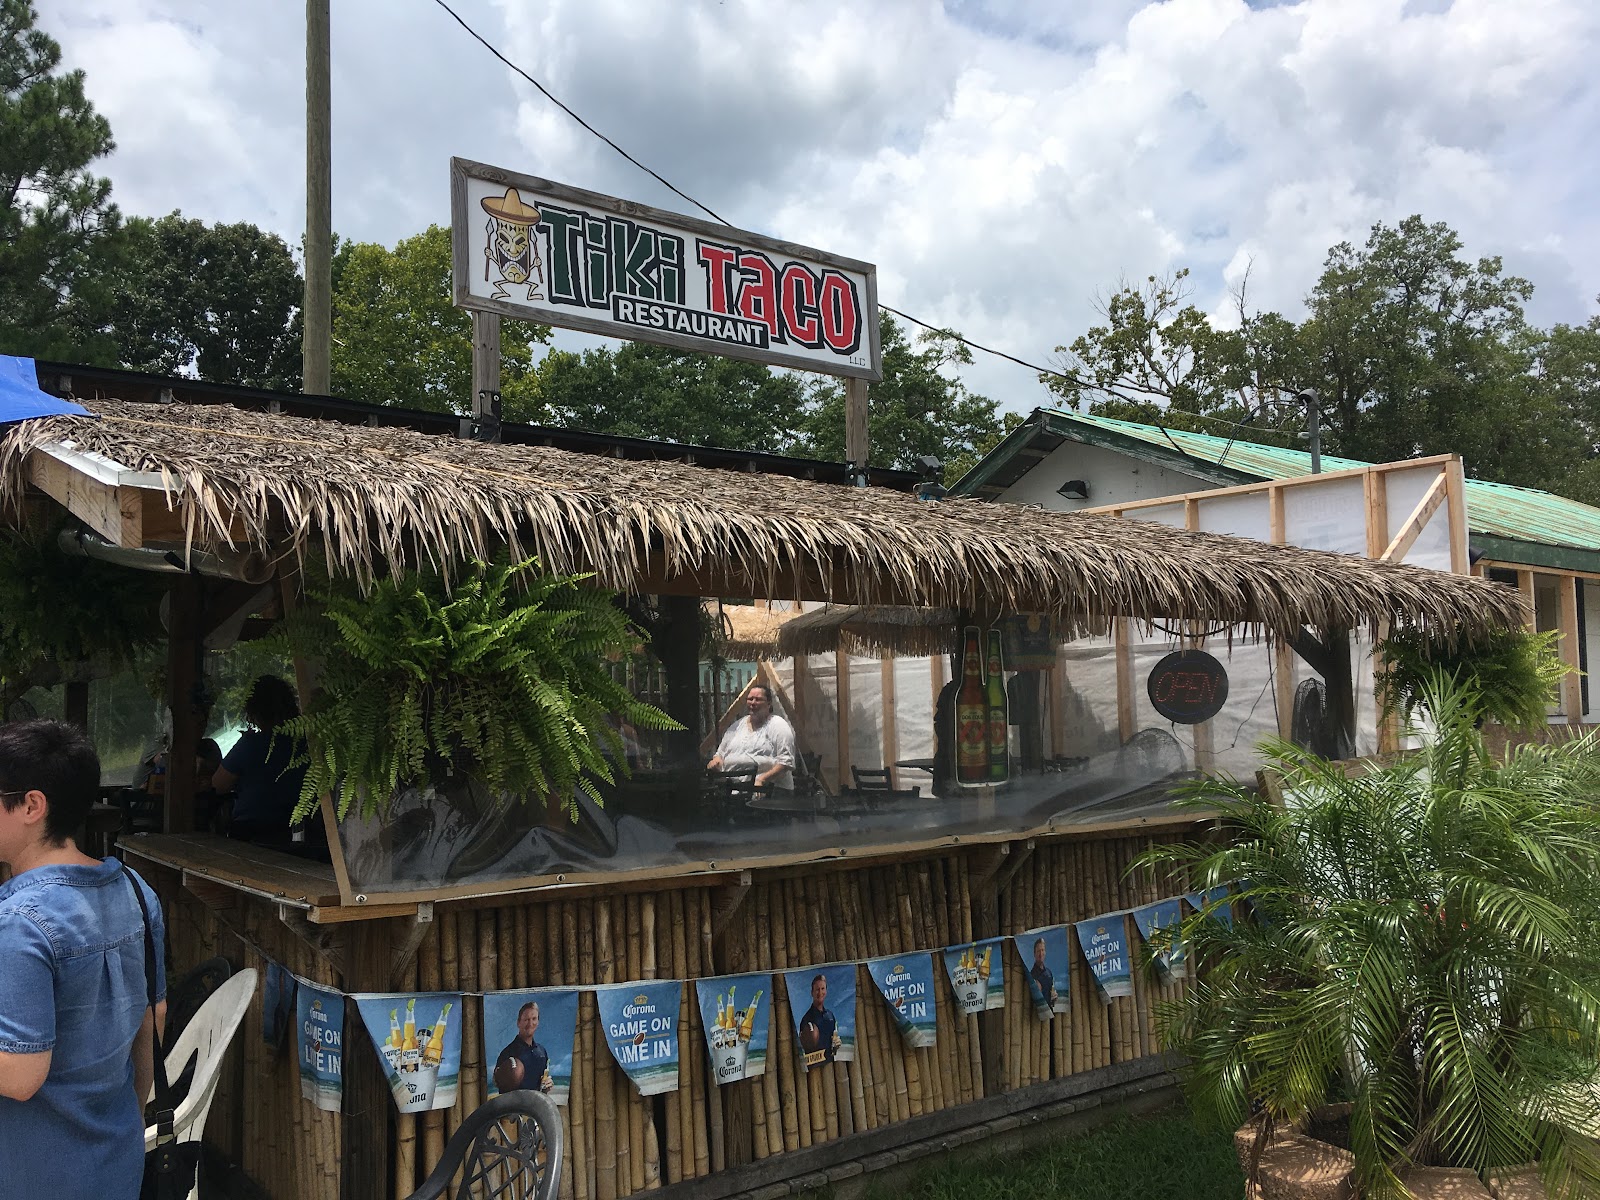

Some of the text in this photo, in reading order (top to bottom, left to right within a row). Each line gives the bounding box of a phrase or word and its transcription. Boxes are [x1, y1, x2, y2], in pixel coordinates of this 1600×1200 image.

[618, 299, 765, 346] RESTAURANT
[849, 356, 866, 367] LLC
[1156, 672, 1220, 703] OPEN
[1085, 941, 1119, 961] GAME ON
[1110, 957, 1122, 973] IN
[885, 972, 911, 986] Corona
[884, 982, 925, 1001] AME ON
[622, 1004, 656, 1019] Corona
[911, 1002, 926, 1018] IN
[610, 1016, 671, 1038] GAME ON
[325, 1029, 341, 1046] ON
[614, 1039, 671, 1064] LIME IN
[328, 1054, 342, 1076] IN
[719, 1064, 742, 1078] Corona
